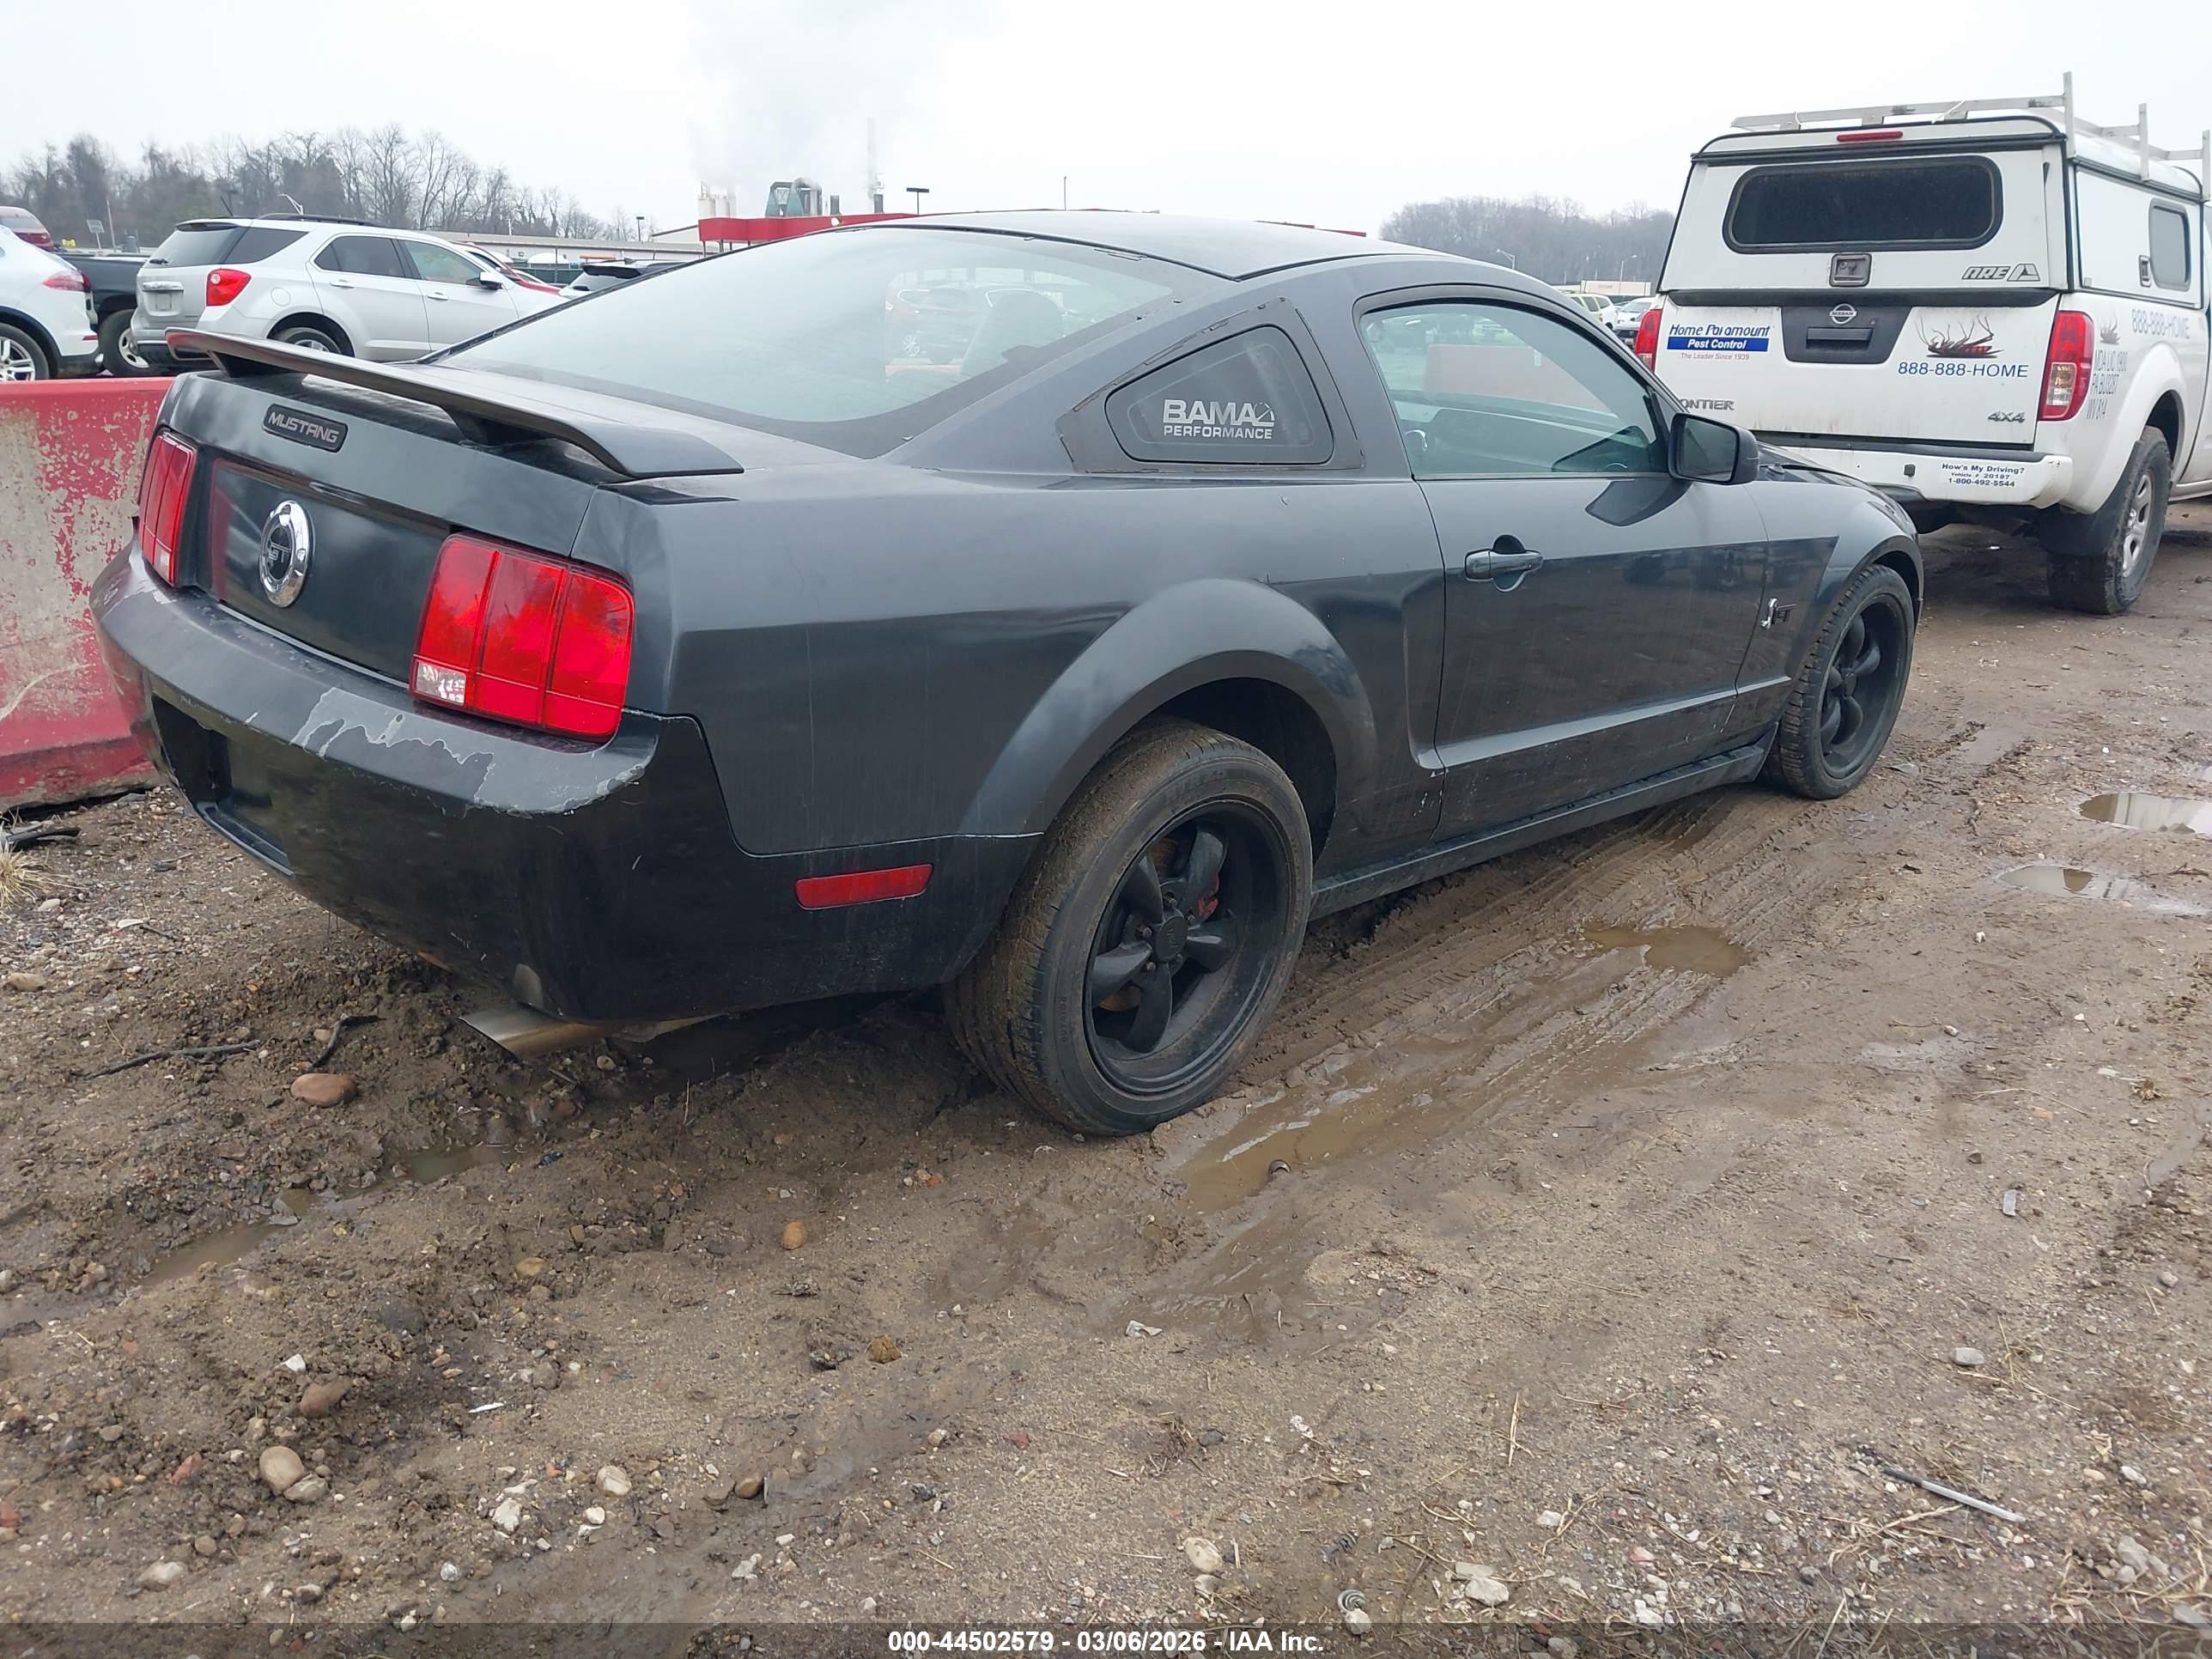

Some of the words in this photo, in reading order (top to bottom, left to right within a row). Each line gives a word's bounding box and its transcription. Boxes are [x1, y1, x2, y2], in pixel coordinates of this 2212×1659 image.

[1961, 266, 2011, 280] ARE
[1668, 324, 1703, 336] Home
[1705, 325, 1771, 337] Paramount
[2131, 308, 2191, 339] 888-888-HOME
[1687, 338, 1709, 349] Pest
[1711, 338, 1747, 349] Control
[1898, 362, 2029, 378] 888-888-HOME
[1680, 398, 1735, 410] ONTIER
[1163, 399, 1262, 427] BAMA
[268, 411, 340, 443] MUSTANG
[1164, 425, 1273, 440] PERFORMANCE
[1986, 465, 2025, 475] Driving?
[1948, 477, 2015, 487] 1-800-492-5544
